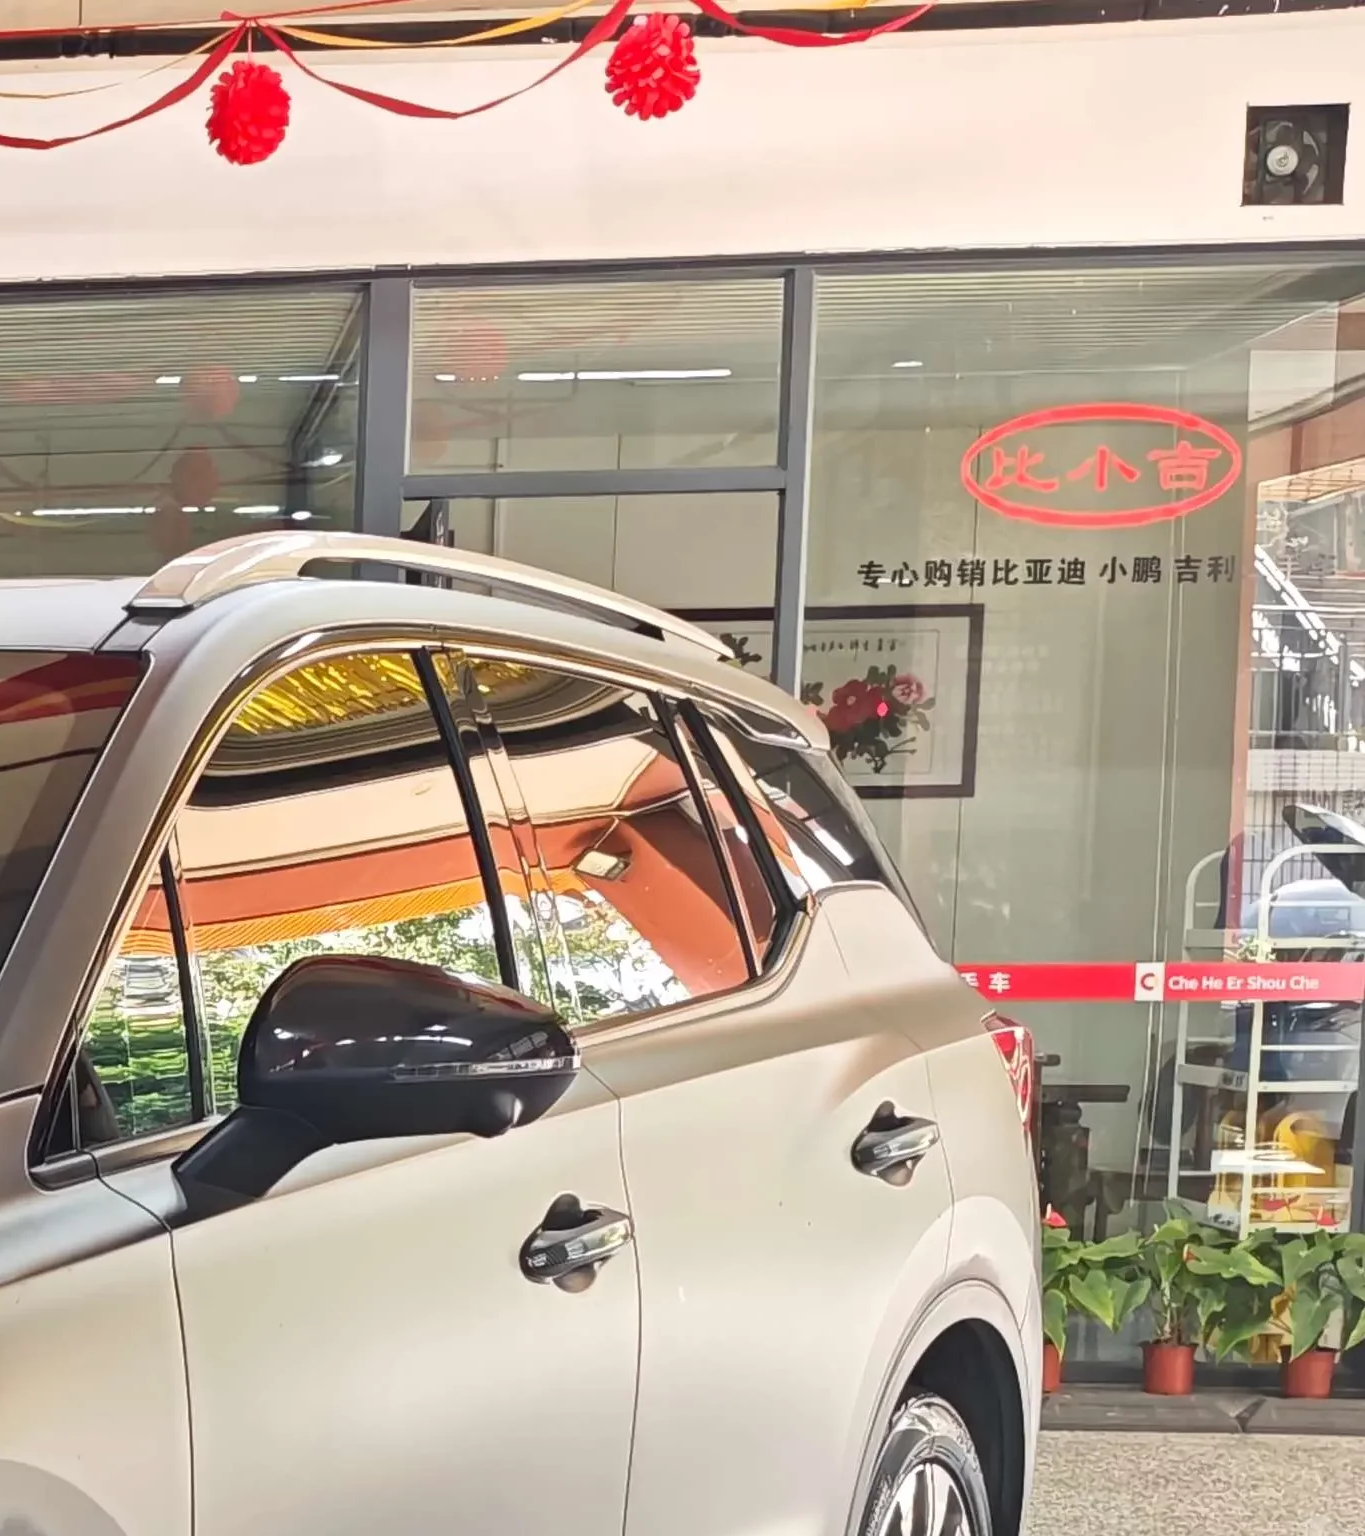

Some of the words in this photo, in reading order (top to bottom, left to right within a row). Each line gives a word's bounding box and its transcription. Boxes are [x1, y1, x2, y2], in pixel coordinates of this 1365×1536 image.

[985, 440, 1223, 492] 比小吉
[857, 557, 1086, 589] 专心购销比亚迪
[1099, 556, 1161, 585] 小鹏
[1173, 555, 1236, 584] 吉利
[1168, 975, 1199, 990] Che
[1201, 975, 1223, 990] He
[1226, 976, 1243, 990] Er
[1246, 976, 1286, 991] Shou
[1289, 975, 1320, 990] Che
